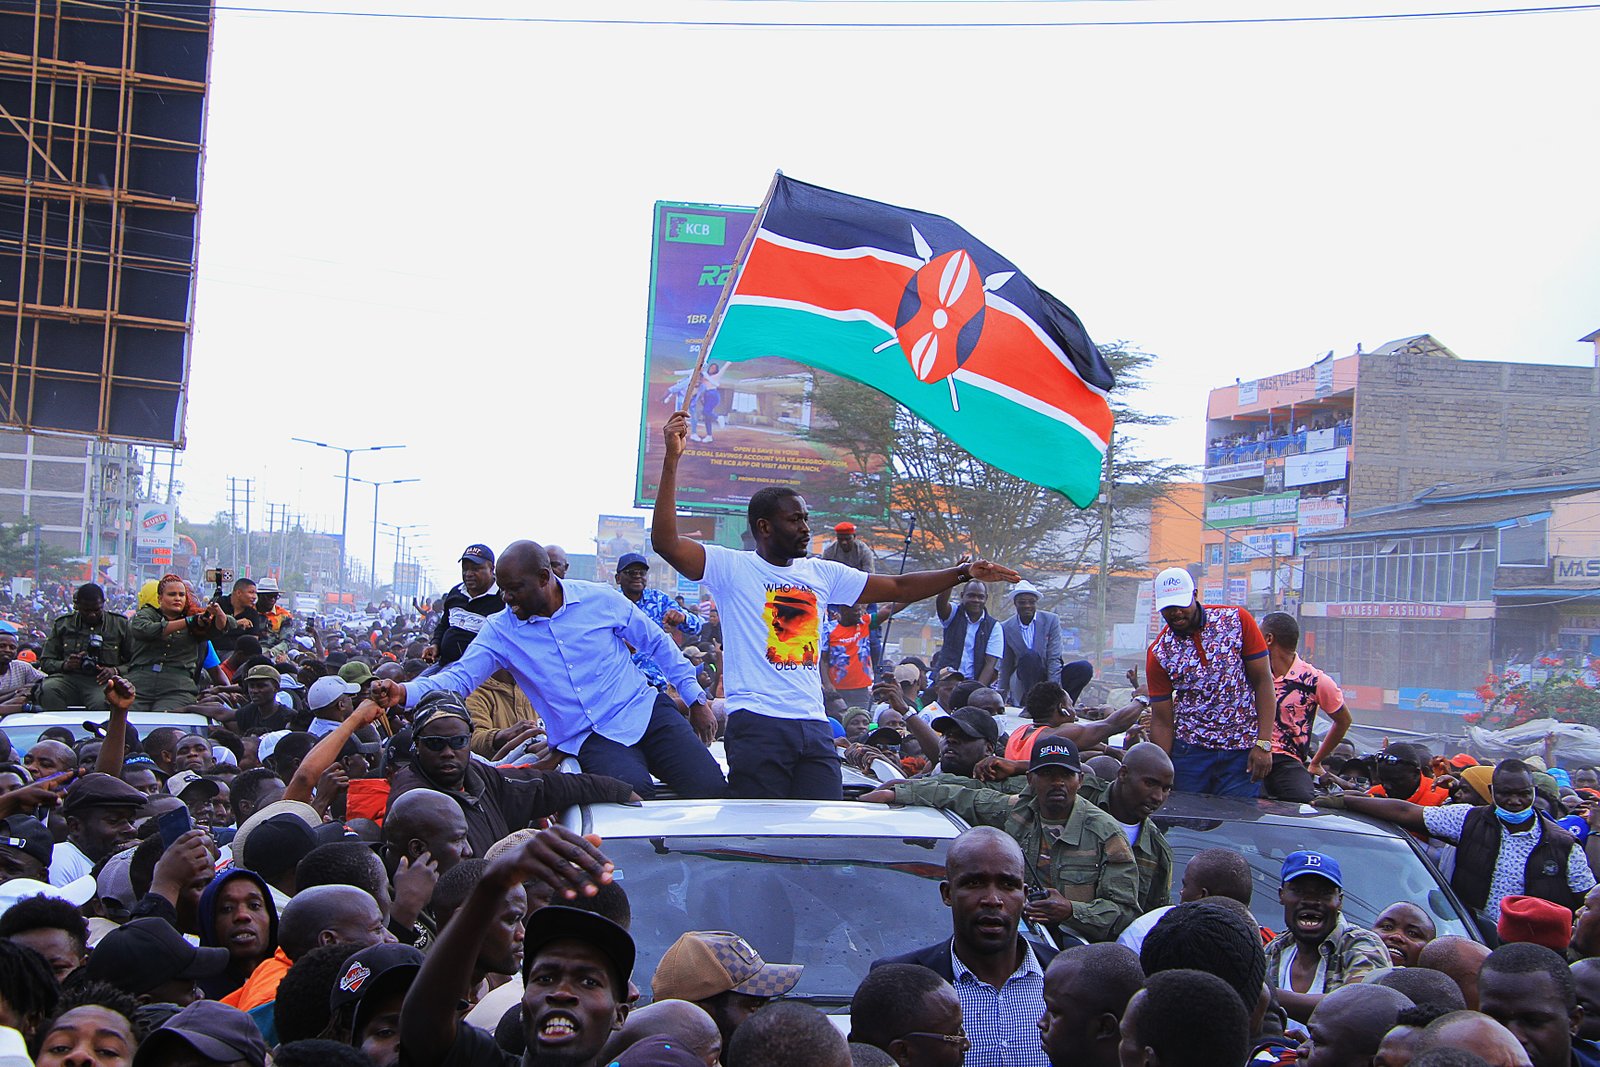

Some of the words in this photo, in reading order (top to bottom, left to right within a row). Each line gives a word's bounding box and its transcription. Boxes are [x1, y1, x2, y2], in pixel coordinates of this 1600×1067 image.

[685, 223, 710, 236] KCB
[686, 313, 708, 325] 1BR
[743, 454, 774, 462] ACCOUNT
[763, 583, 791, 593] WHO
[1341, 605, 1380, 615] KAMESH
[1388, 605, 1442, 617] FASHIONS
[769, 660, 798, 671] OLD
[1040, 745, 1070, 754] SIFUNA
[1304, 854, 1321, 867] E
